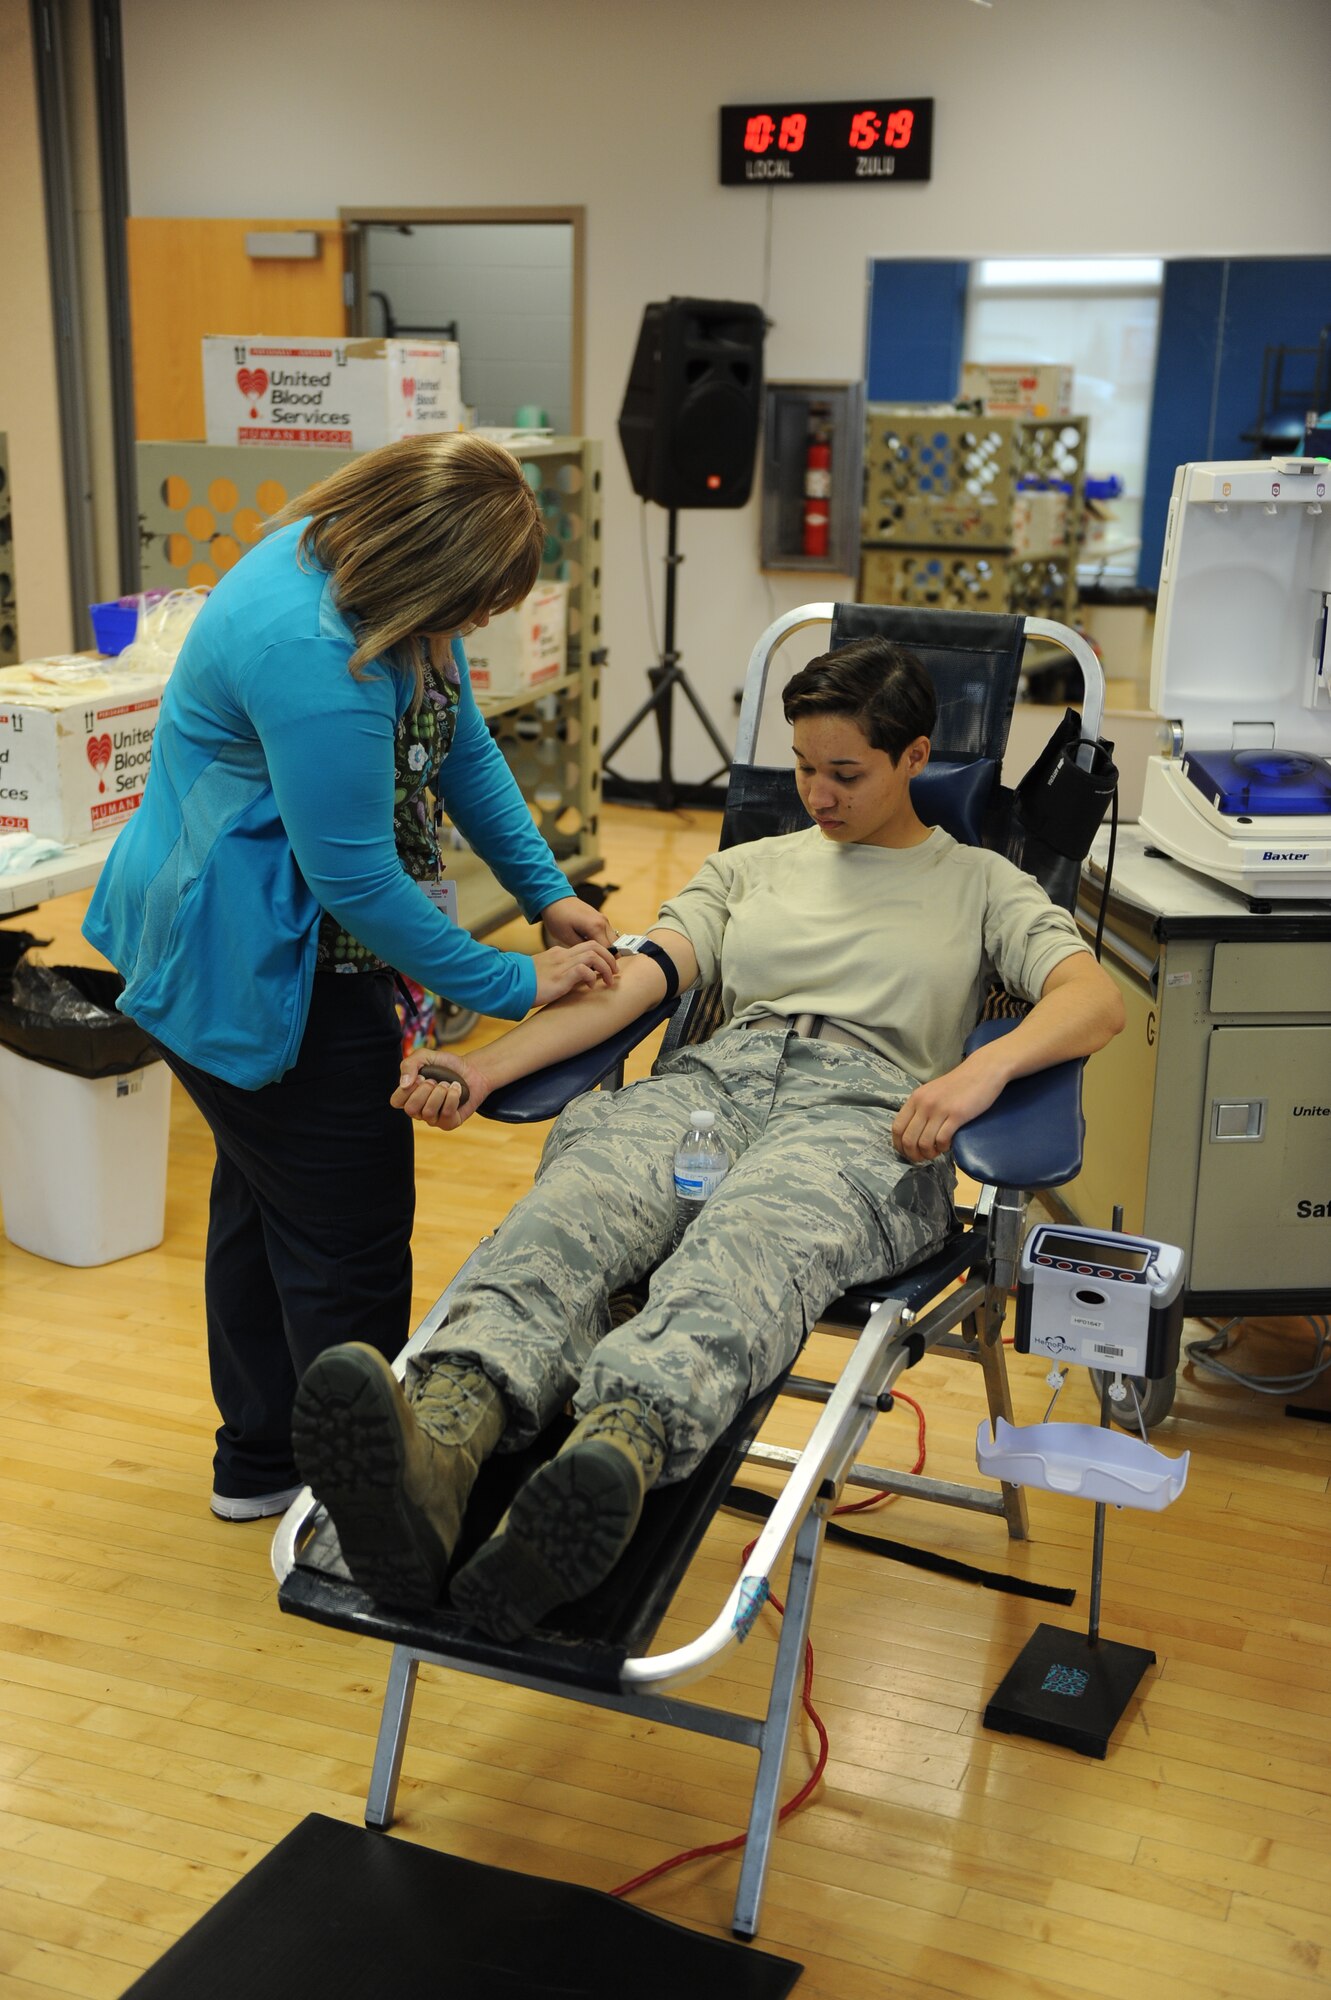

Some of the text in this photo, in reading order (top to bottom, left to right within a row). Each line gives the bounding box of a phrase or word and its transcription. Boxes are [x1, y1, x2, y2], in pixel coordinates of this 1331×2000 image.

[743, 109, 914, 153] 10:19 15:19
[745, 156, 895, 178] LOCAL ZULU
[271, 371, 332, 387] United
[271, 390, 323, 405] Blood
[272, 408, 351, 425] Services
[239, 430, 351, 442] HUMAN BLOOD
[92, 797, 135, 819] HUMAN
[1262, 851, 1310, 861] Baxter
[1292, 1105, 1331, 1117] Unite
[1034, 1337, 1077, 1352] HemoFlow
